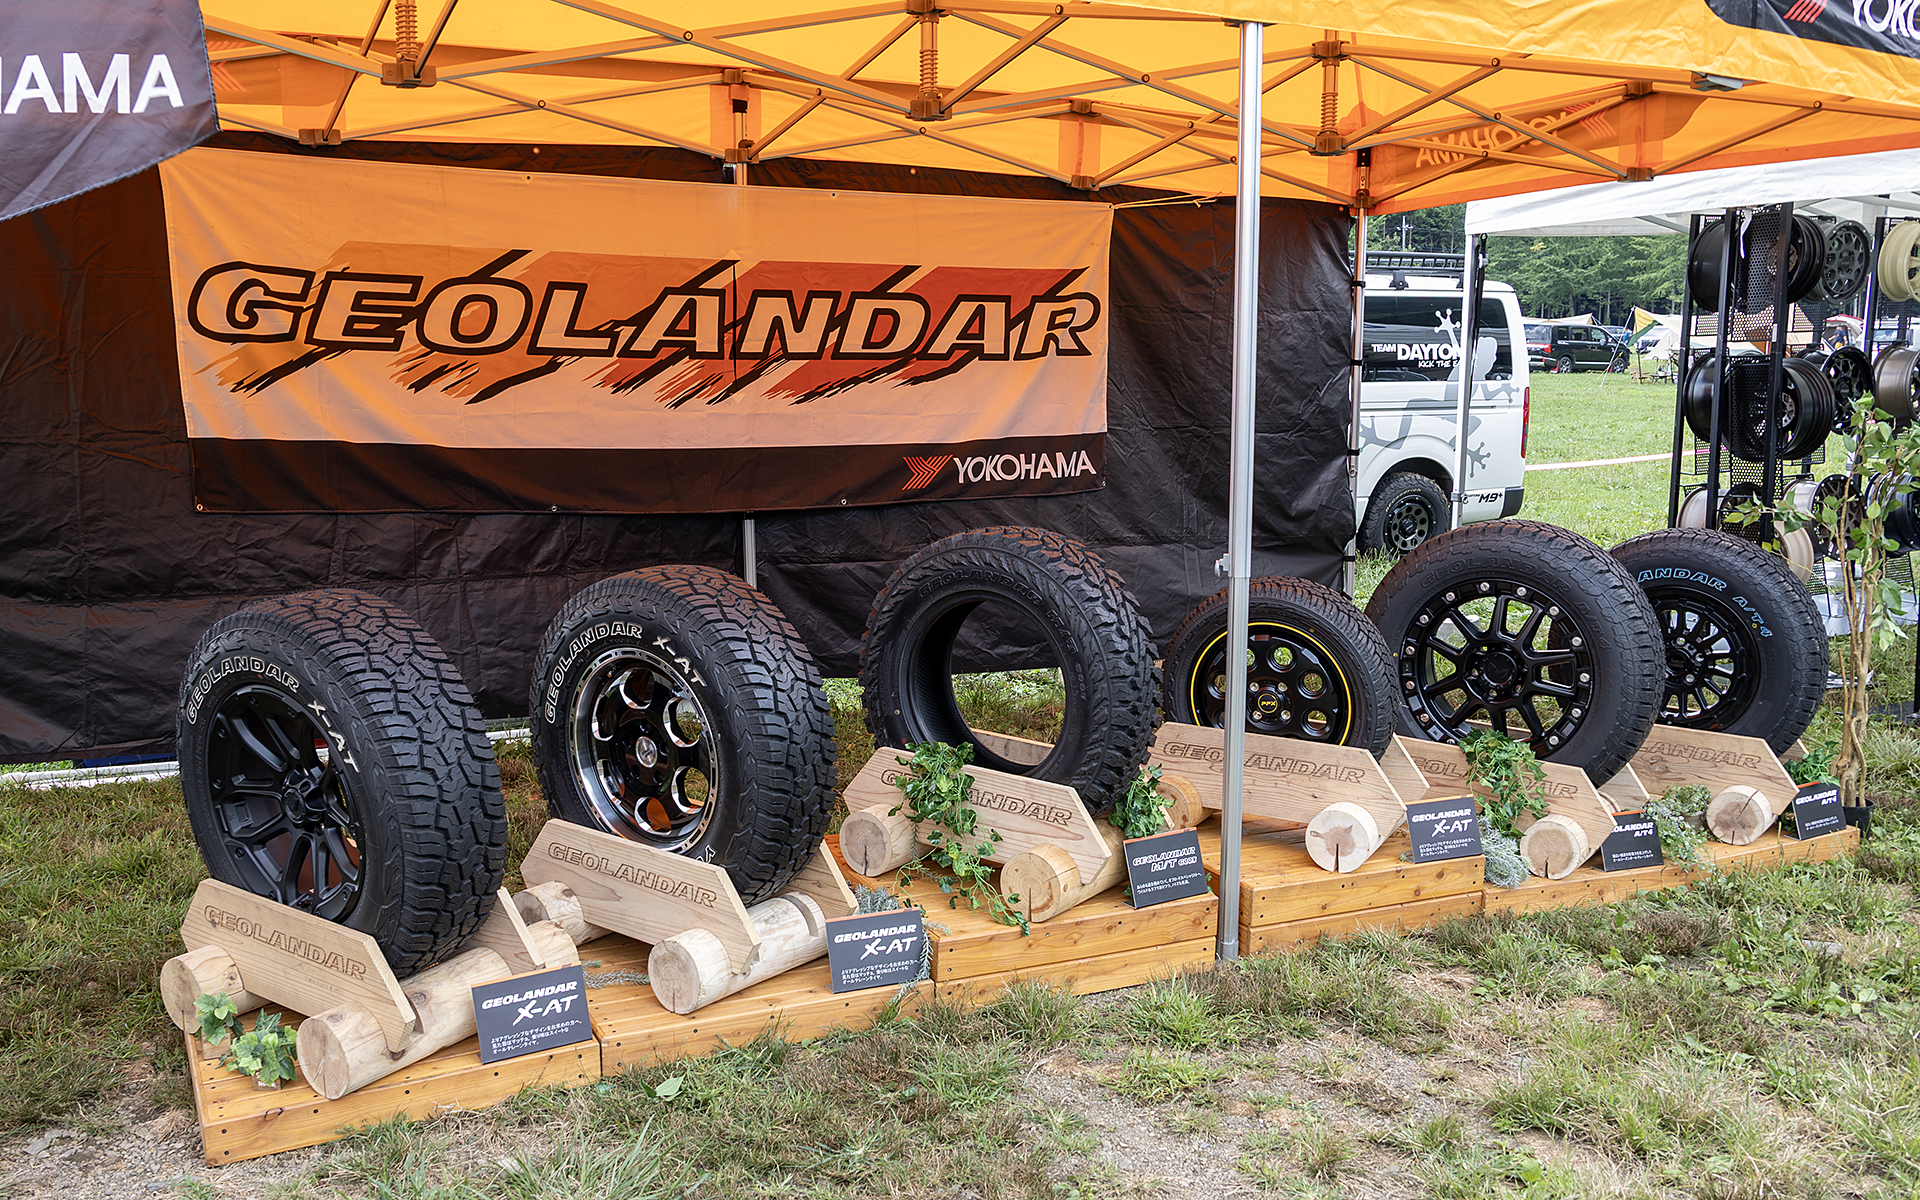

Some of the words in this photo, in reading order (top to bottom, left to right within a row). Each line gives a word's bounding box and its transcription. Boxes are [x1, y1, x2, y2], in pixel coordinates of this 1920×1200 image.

[0, 52, 184, 114] AMA
[187, 260, 1101, 362] GEOLANDAR
[1371, 344, 1396, 353] TEAM
[1418, 360, 1434, 368] KICK
[1436, 360, 1451, 368] THE
[953, 449, 1097, 484] YOKOHAMA
[918, 569, 1043, 606] GEOLANDAR
[1421, 556, 1572, 593] GEOLANDAR
[544, 621, 643, 724] GEOLANDAR
[652, 636, 707, 687] X-AT
[186, 656, 300, 725] GEOLANDAR
[308, 700, 361, 774] X-AT
[1163, 741, 1366, 784] GEOANDAR
[1412, 808, 1472, 823] GEOLANDAR
[1432, 819, 1473, 838] X-AT
[1611, 822, 1654, 833] OLANDAR
[1133, 846, 1196, 867] GEOLANDAR
[1151, 858, 1177, 872] M/T
[548, 842, 717, 909] GEOLANDAR
[204, 905, 367, 980] GEOLANDAR
[834, 924, 917, 944] GEOLANDAR
[860, 937, 918, 961] X-AT
[482, 981, 578, 1010] GEOLANDAR
[513, 994, 579, 1026] X-AT
